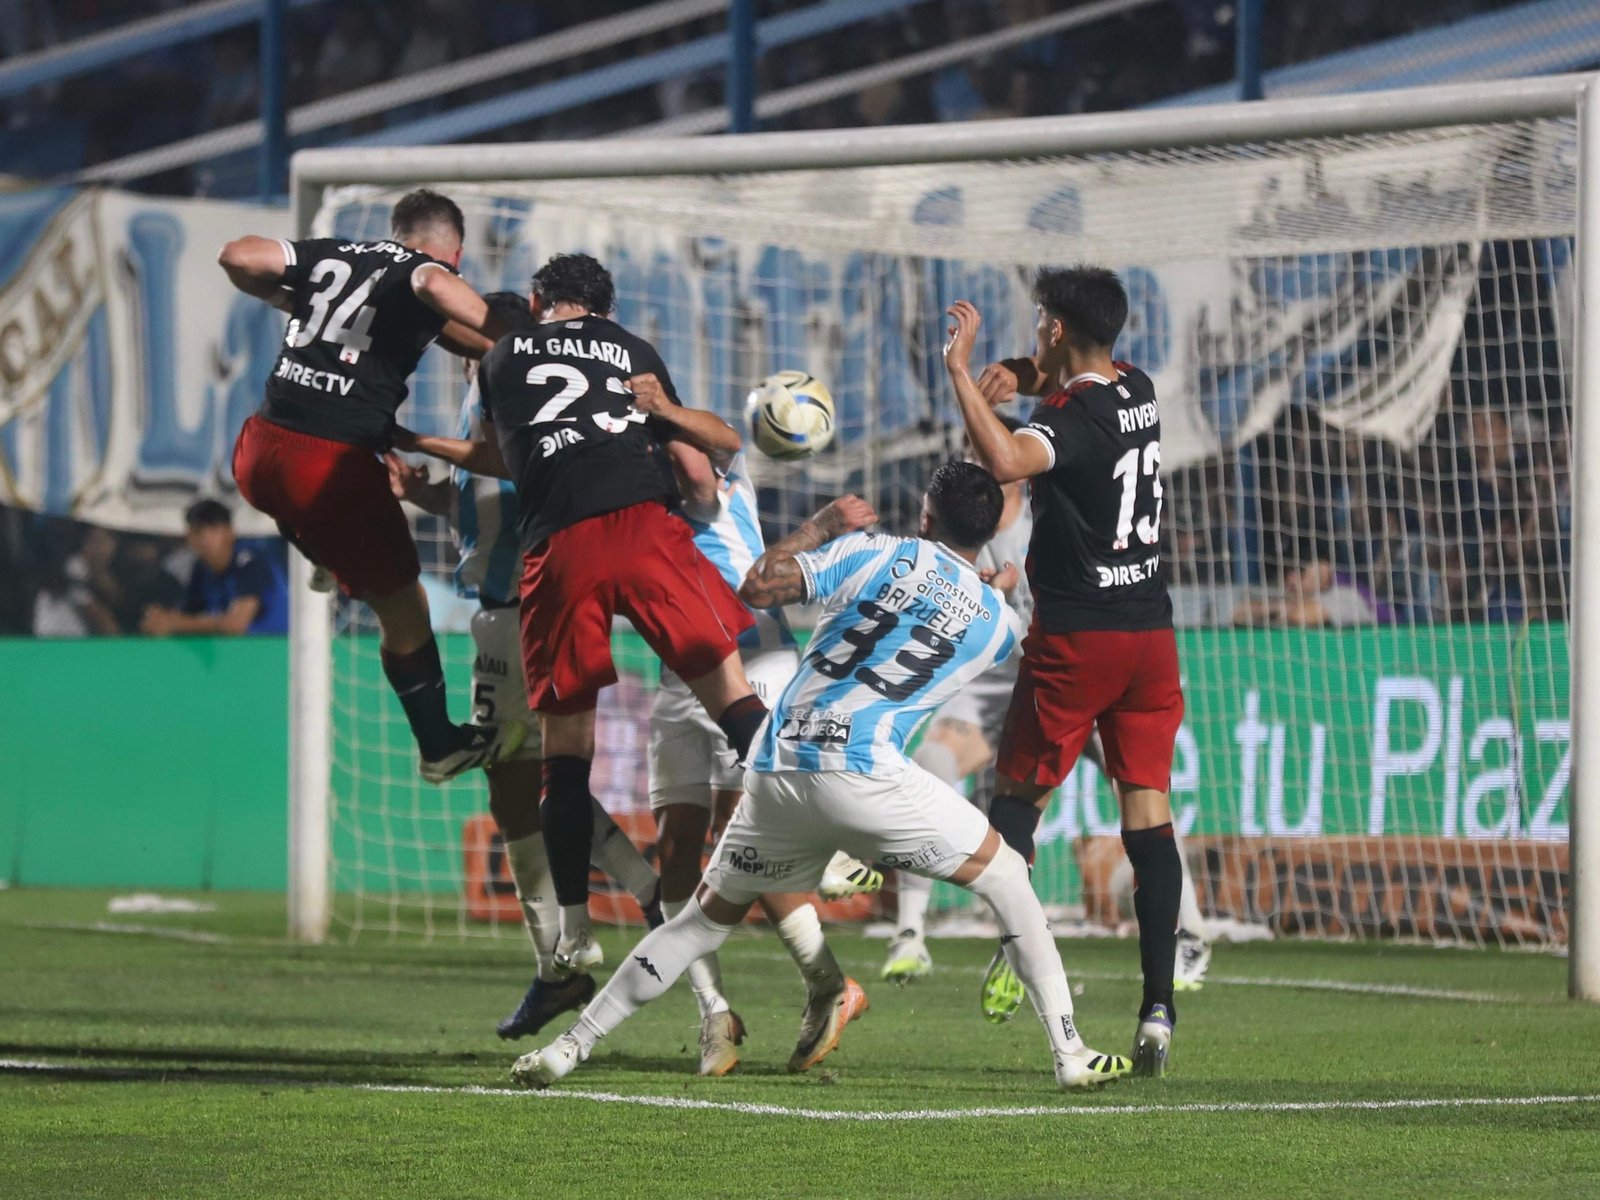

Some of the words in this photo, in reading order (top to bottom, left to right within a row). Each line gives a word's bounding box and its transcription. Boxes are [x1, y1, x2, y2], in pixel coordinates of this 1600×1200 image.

[286, 258, 388, 365] 34
[513, 336, 541, 355] M.
[545, 337, 632, 374] GALARZA
[1117, 399, 1160, 434] RIVER
[876, 582, 969, 646] BRIZUELA
[916, 582, 933, 600] al
[933, 592, 973, 625] Costo
[925, 568, 991, 622] Construyo
[1234, 689, 1325, 838] tu
